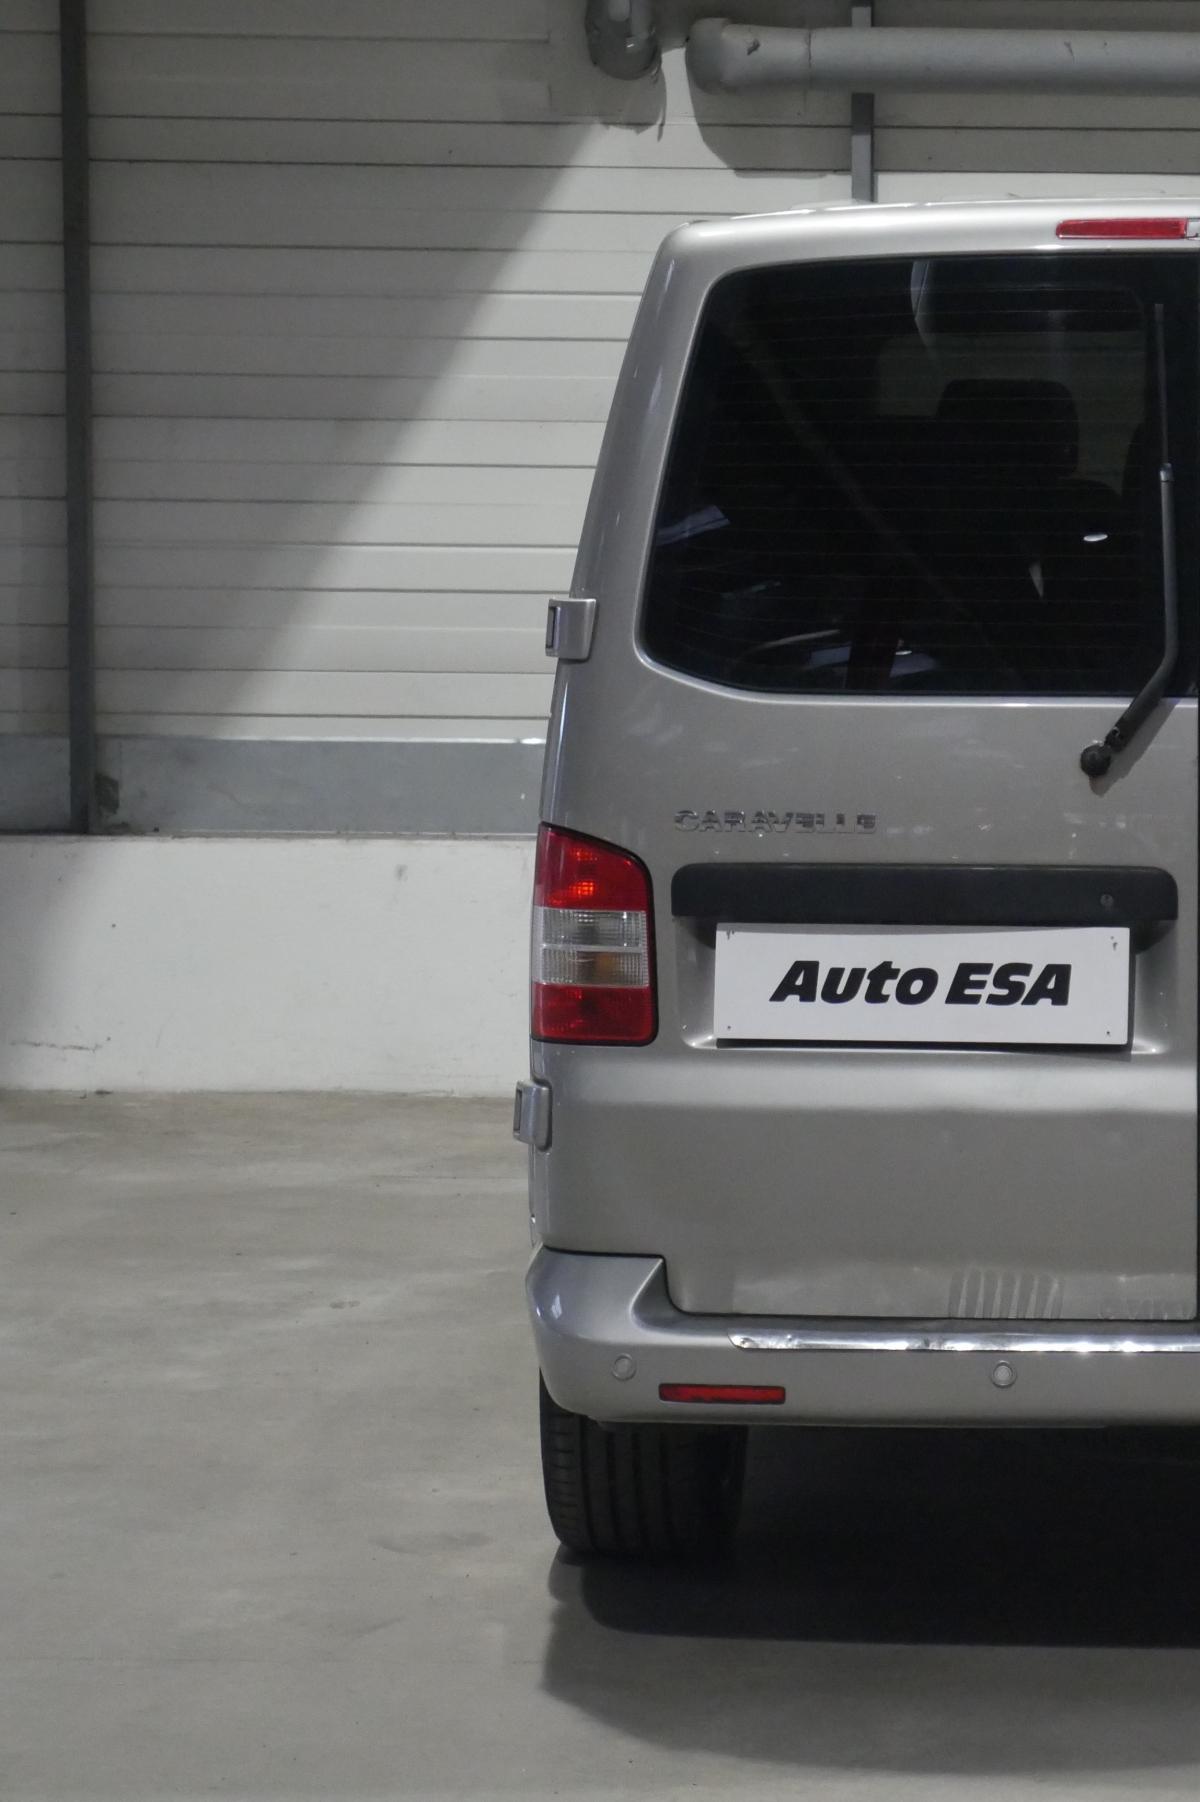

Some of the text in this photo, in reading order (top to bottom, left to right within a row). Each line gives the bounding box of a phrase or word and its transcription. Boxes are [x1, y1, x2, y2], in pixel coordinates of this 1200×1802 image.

[674, 809, 878, 834] CARAVELLE
[769, 960, 1072, 1006] Auto ESA
